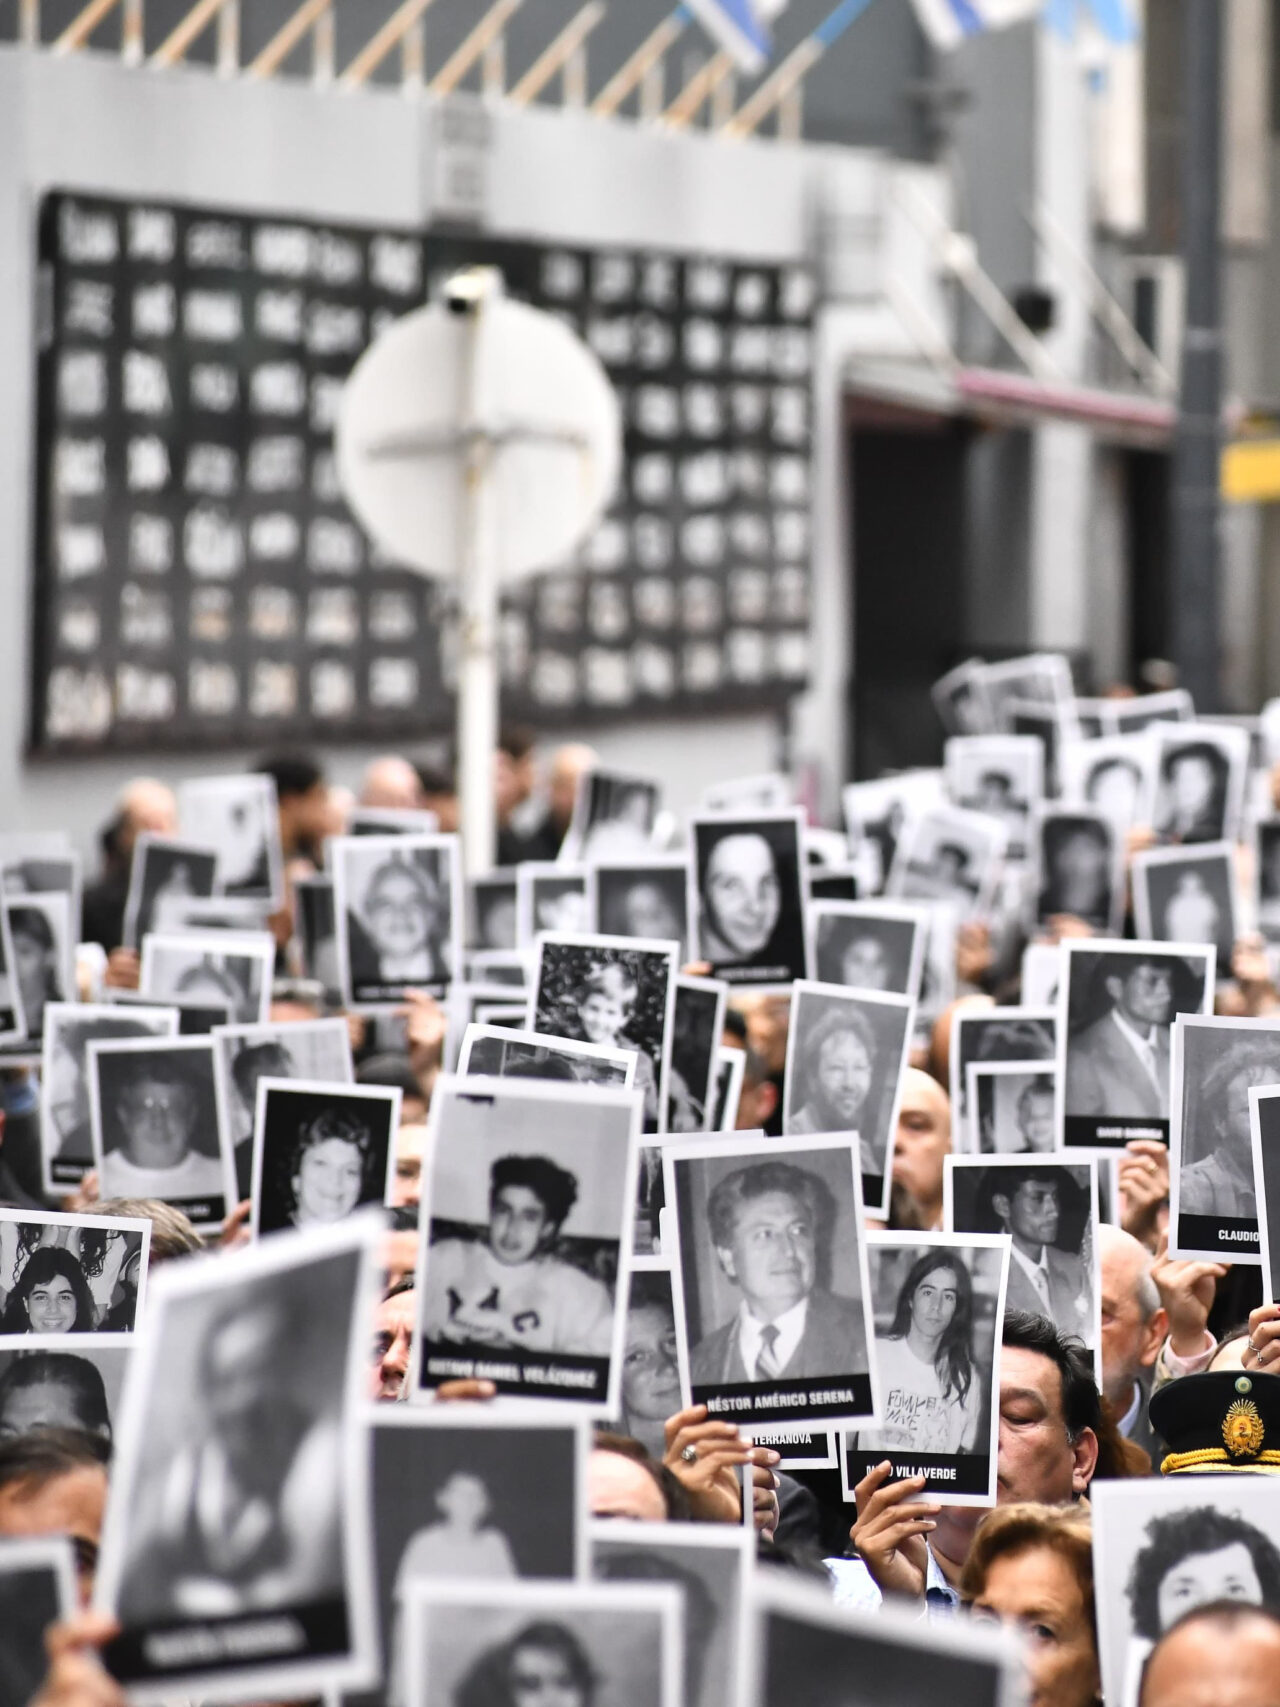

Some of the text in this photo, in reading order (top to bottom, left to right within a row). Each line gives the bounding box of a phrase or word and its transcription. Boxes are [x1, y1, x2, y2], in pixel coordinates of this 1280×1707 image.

[1218, 1229, 1259, 1242] CLAUDIO
[707, 1390, 854, 1412] NÉSTOR AMÉRICO SERENA
[754, 1433, 812, 1445] TERRANOVA
[896, 1466, 957, 1480] VILLAVERDE
